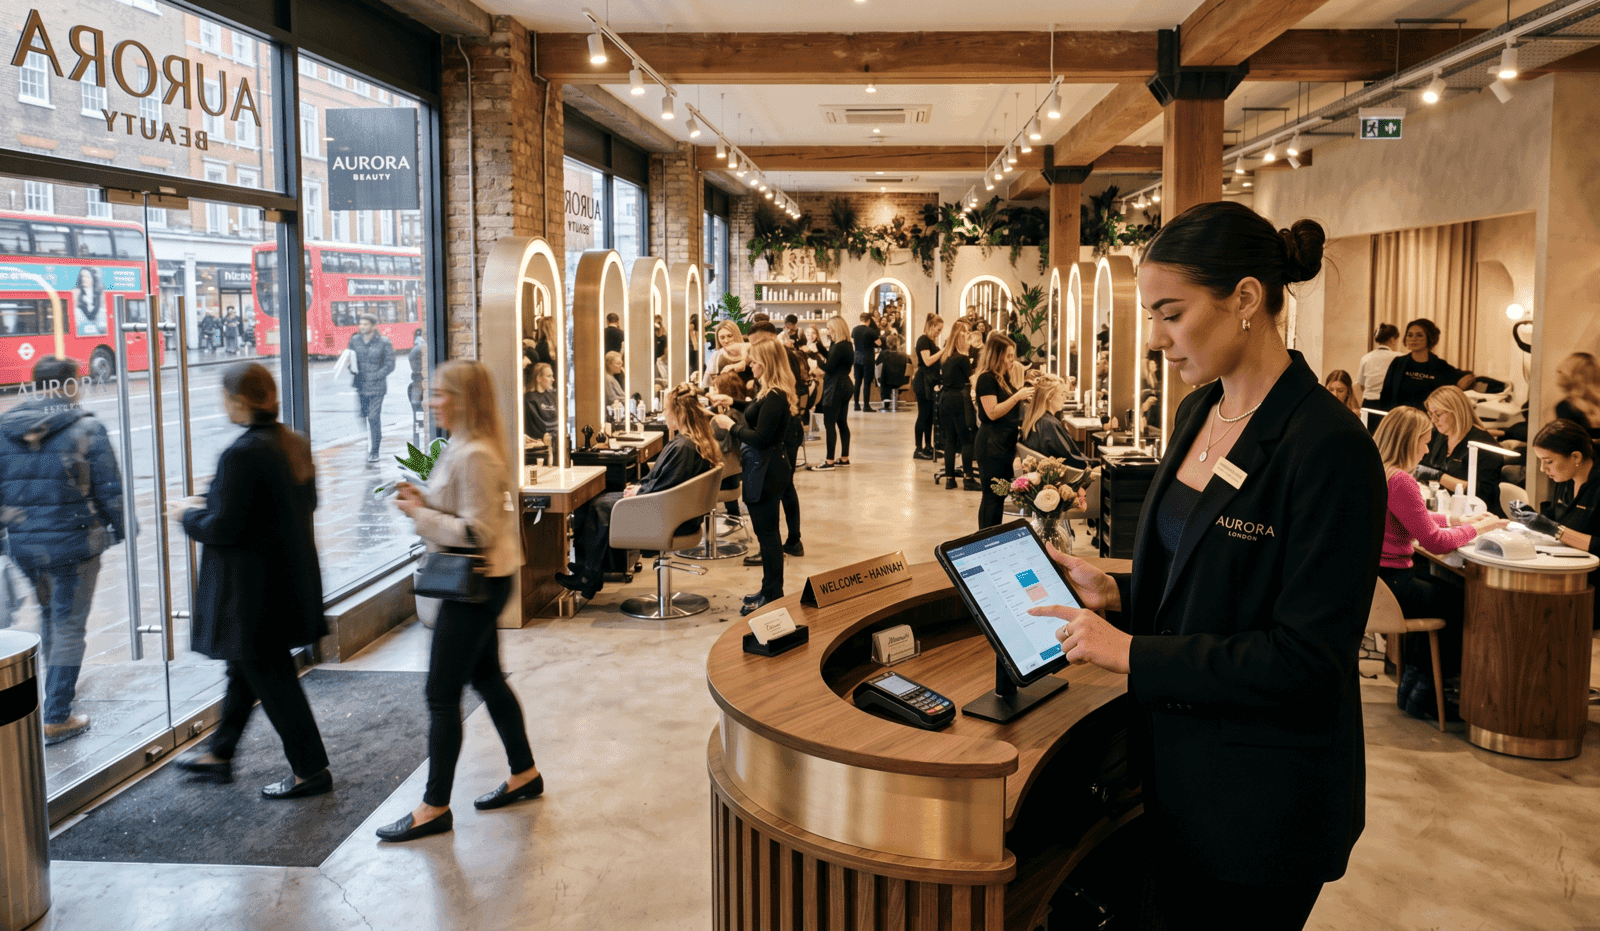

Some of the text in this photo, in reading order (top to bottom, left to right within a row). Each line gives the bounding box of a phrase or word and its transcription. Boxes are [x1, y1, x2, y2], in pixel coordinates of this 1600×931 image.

[332, 155, 411, 171] AURORA
[352, 173, 391, 181] BEAUTY
[16, 375, 108, 402] AURORA
[1215, 515, 1275, 538] AURORA
[1227, 530, 1258, 542] LONDON
[819, 572, 864, 595] WELCOME
[868, 560, 905, 580] HANNAH
